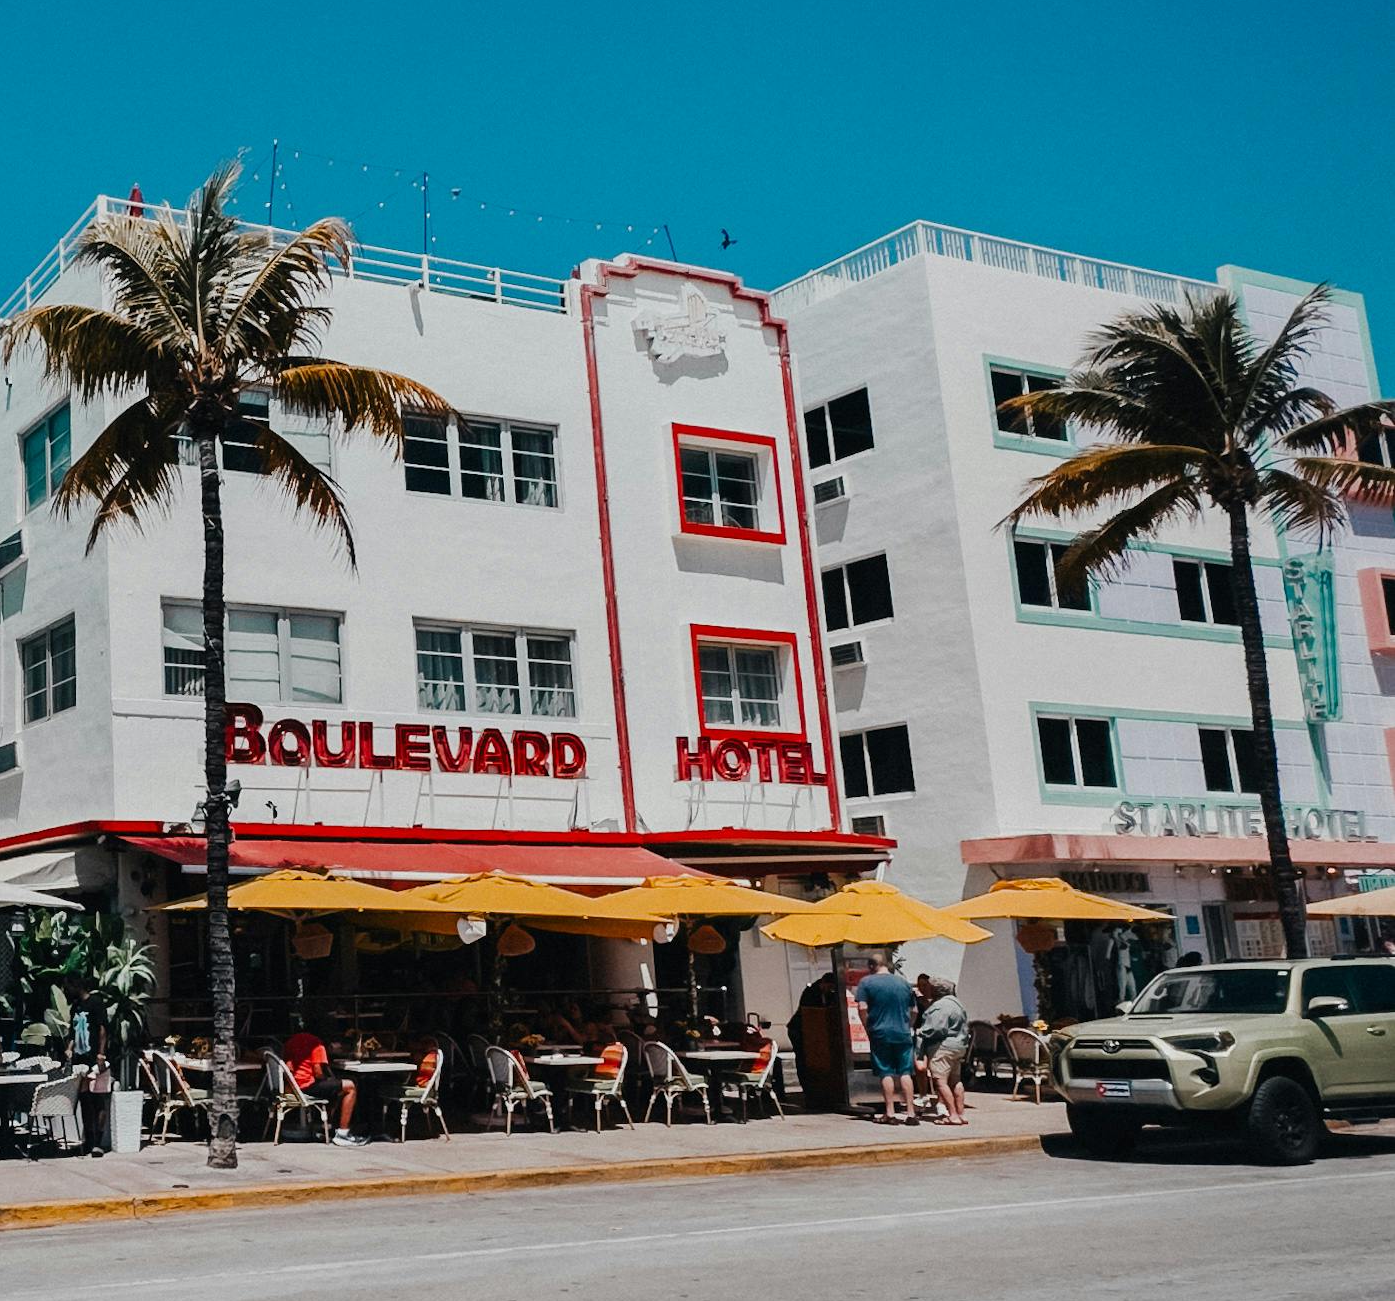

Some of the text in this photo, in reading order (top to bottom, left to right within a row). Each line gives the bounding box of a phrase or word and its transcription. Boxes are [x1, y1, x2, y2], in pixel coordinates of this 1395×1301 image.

[224, 701, 828, 786] BOULEVARD HOTEL
[1114, 800, 1378, 843] STARLITE HOTEL
